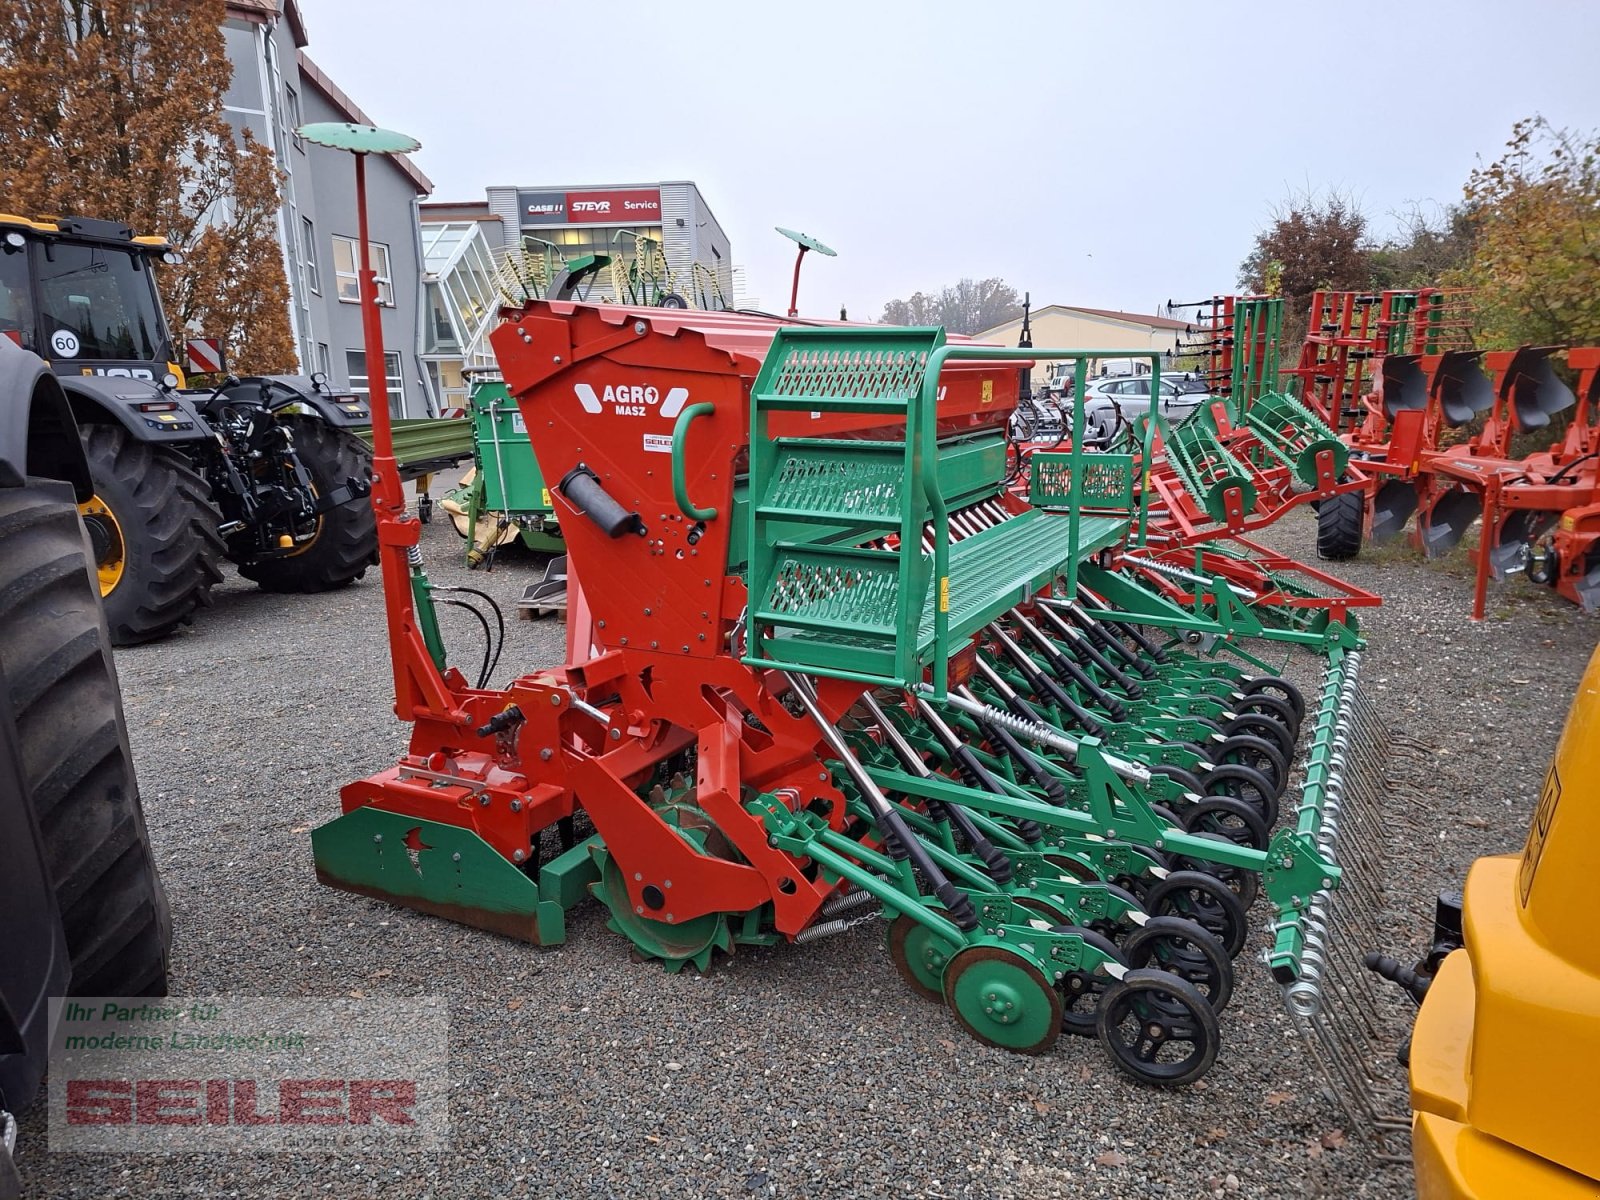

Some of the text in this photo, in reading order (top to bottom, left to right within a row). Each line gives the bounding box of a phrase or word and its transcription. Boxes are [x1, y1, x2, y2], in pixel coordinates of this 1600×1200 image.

[528, 204, 553, 212] CASE
[572, 201, 611, 212] STEYR
[624, 199, 658, 210] Service
[55, 337, 76, 350] 60
[602, 385, 659, 405] AGRO
[615, 405, 647, 416] MASZ
